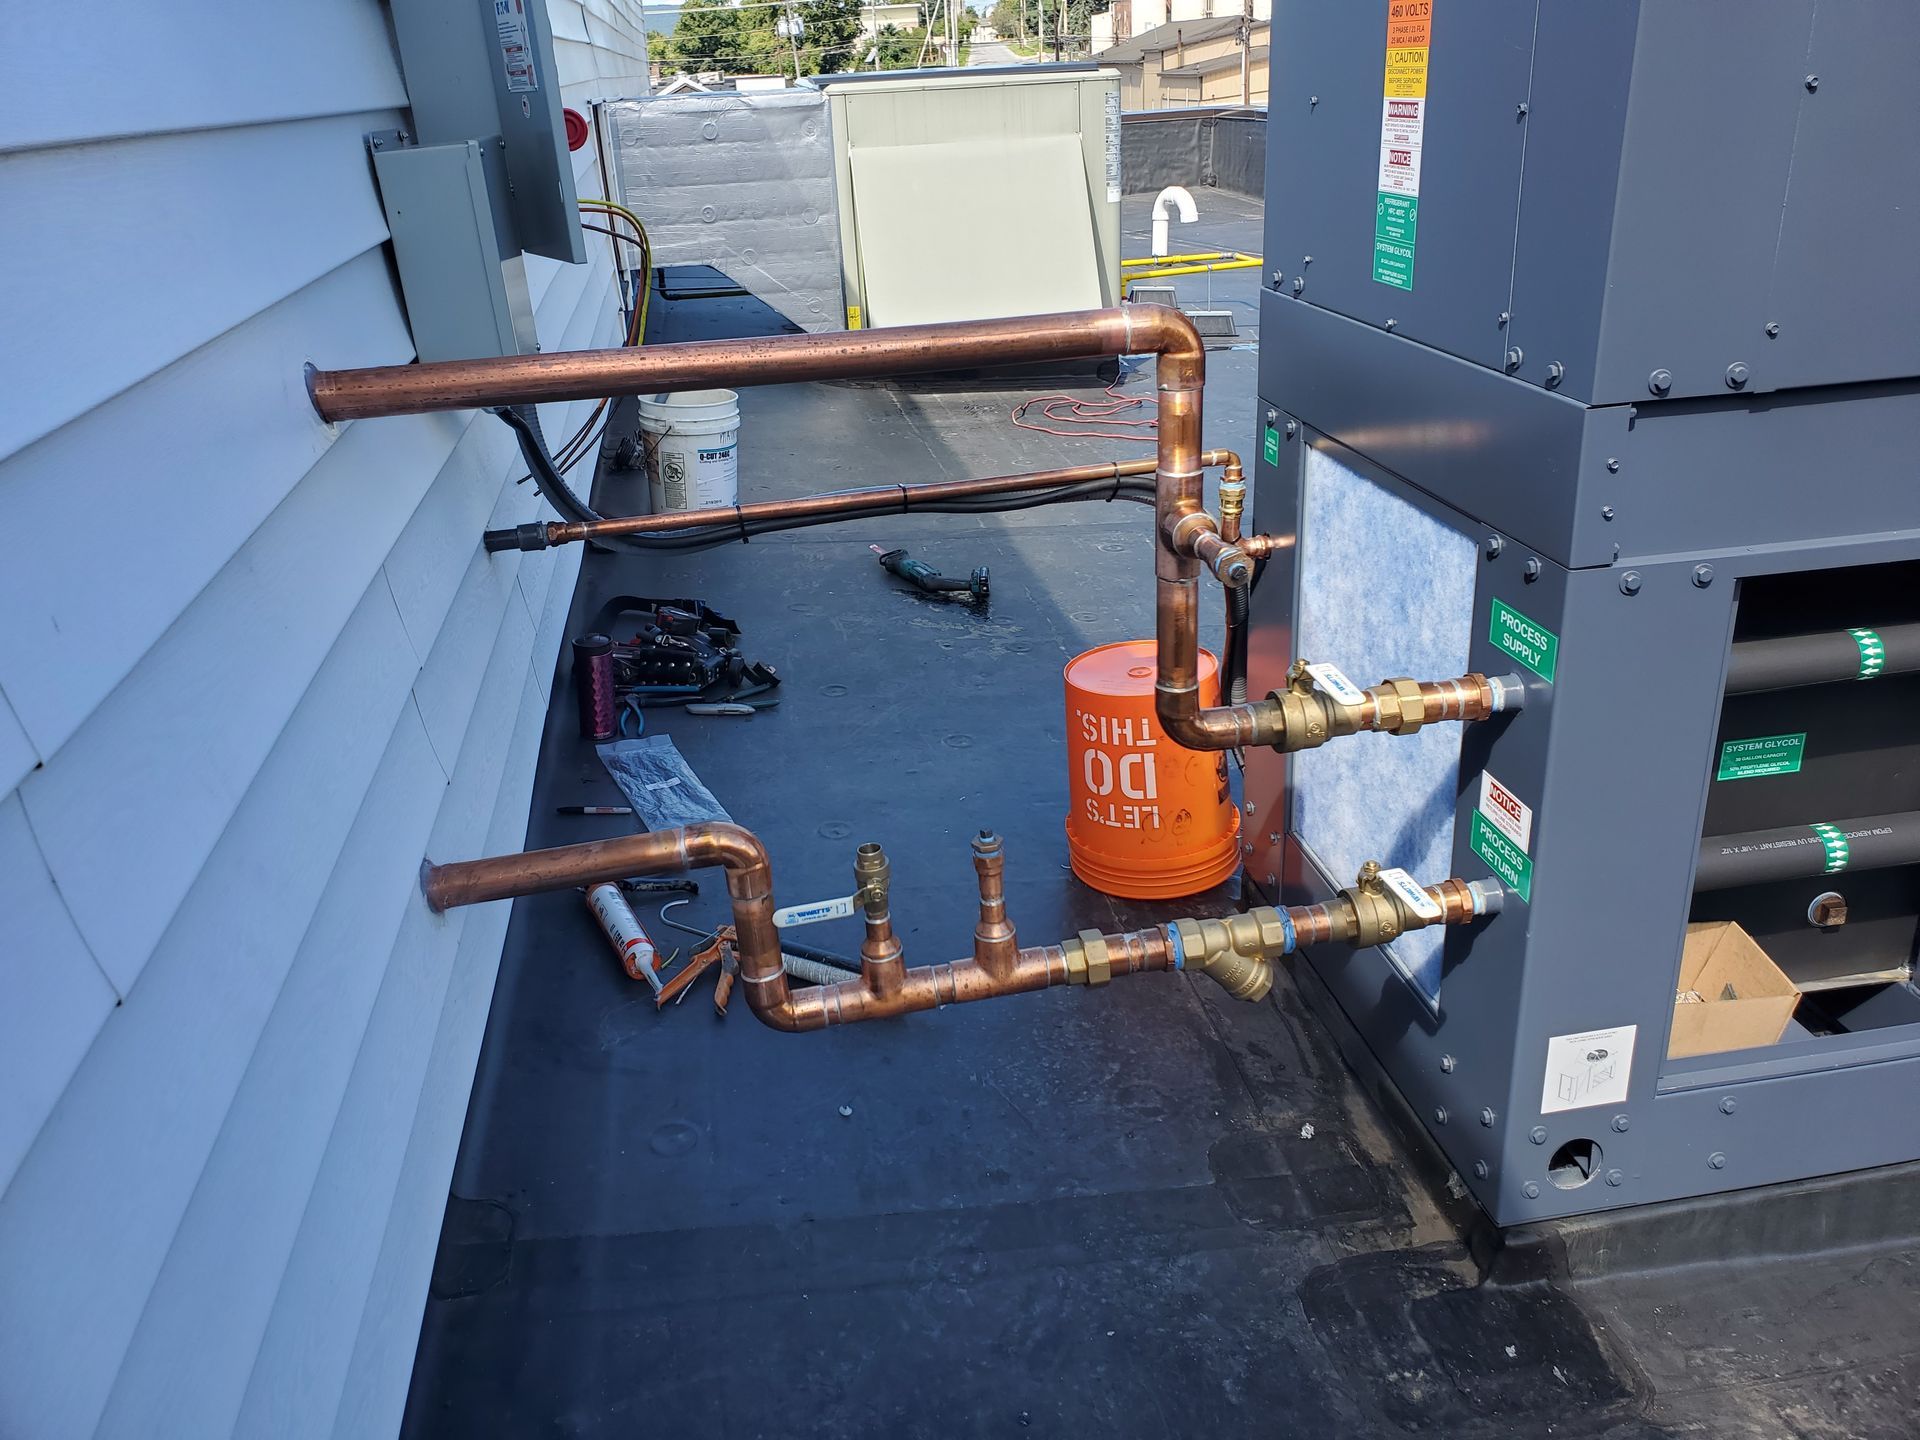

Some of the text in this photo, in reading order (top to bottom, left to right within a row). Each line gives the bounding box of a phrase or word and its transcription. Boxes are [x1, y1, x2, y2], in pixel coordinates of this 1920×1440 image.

[1392, 3, 1428, 17] 460 VOLTS
[1395, 52, 1424, 63] CAUTION
[1388, 103, 1418, 117] WARNING
[1389, 151, 1411, 165] NOTICE
[1376, 242, 1412, 259] SYSTEM GLYCOL
[1500, 610, 1548, 651] PROCESS
[1503, 633, 1541, 667] SUPPLY
[1726, 738, 1800, 753] SYSTEM GLYCOL
[1083, 748, 1158, 800] DO
[1489, 783, 1522, 820] NOTICE
[1086, 798, 1160, 829] LET'S
[1798, 838, 1808, 846] UV
[1842, 830, 1872, 839] AEROCE
[1480, 822, 1523, 871] PROCESS
[1759, 840, 1797, 850] RESISTANT
[1481, 842, 1519, 886] RETURN
[797, 907, 831, 917] WATTS
